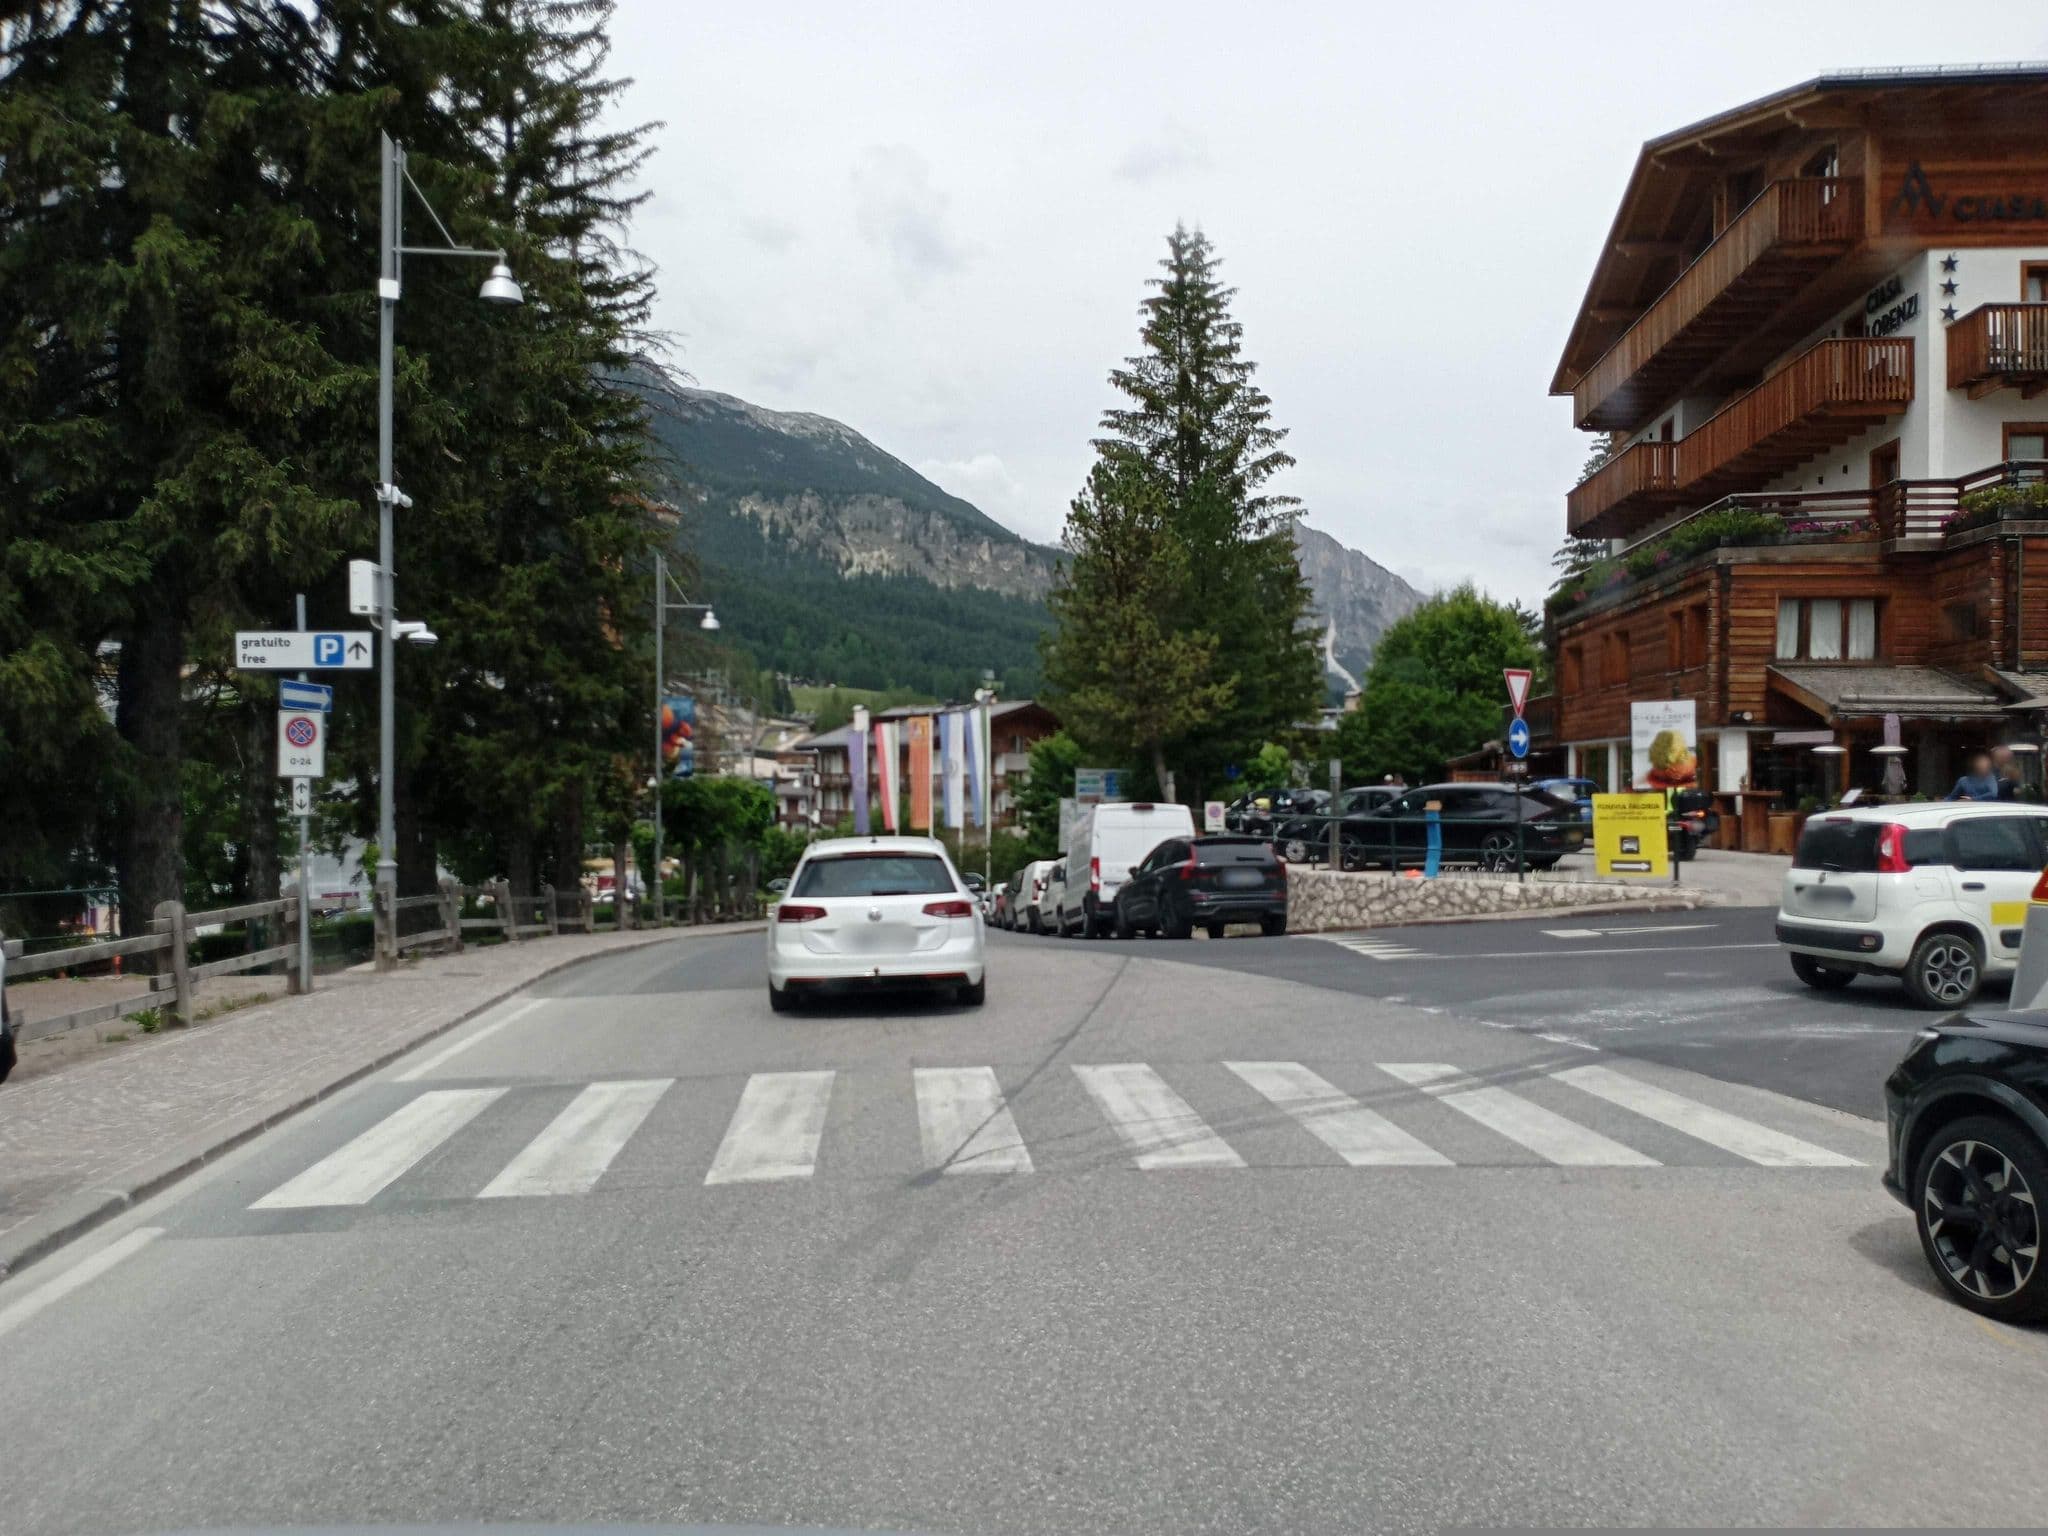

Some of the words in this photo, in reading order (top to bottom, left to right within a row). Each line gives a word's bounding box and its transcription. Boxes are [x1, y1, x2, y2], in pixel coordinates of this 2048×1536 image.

[241, 637, 291, 649] gratuito
[320, 638, 339, 662] P
[241, 653, 267, 664] free
[289, 757, 312, 766] 0-24
